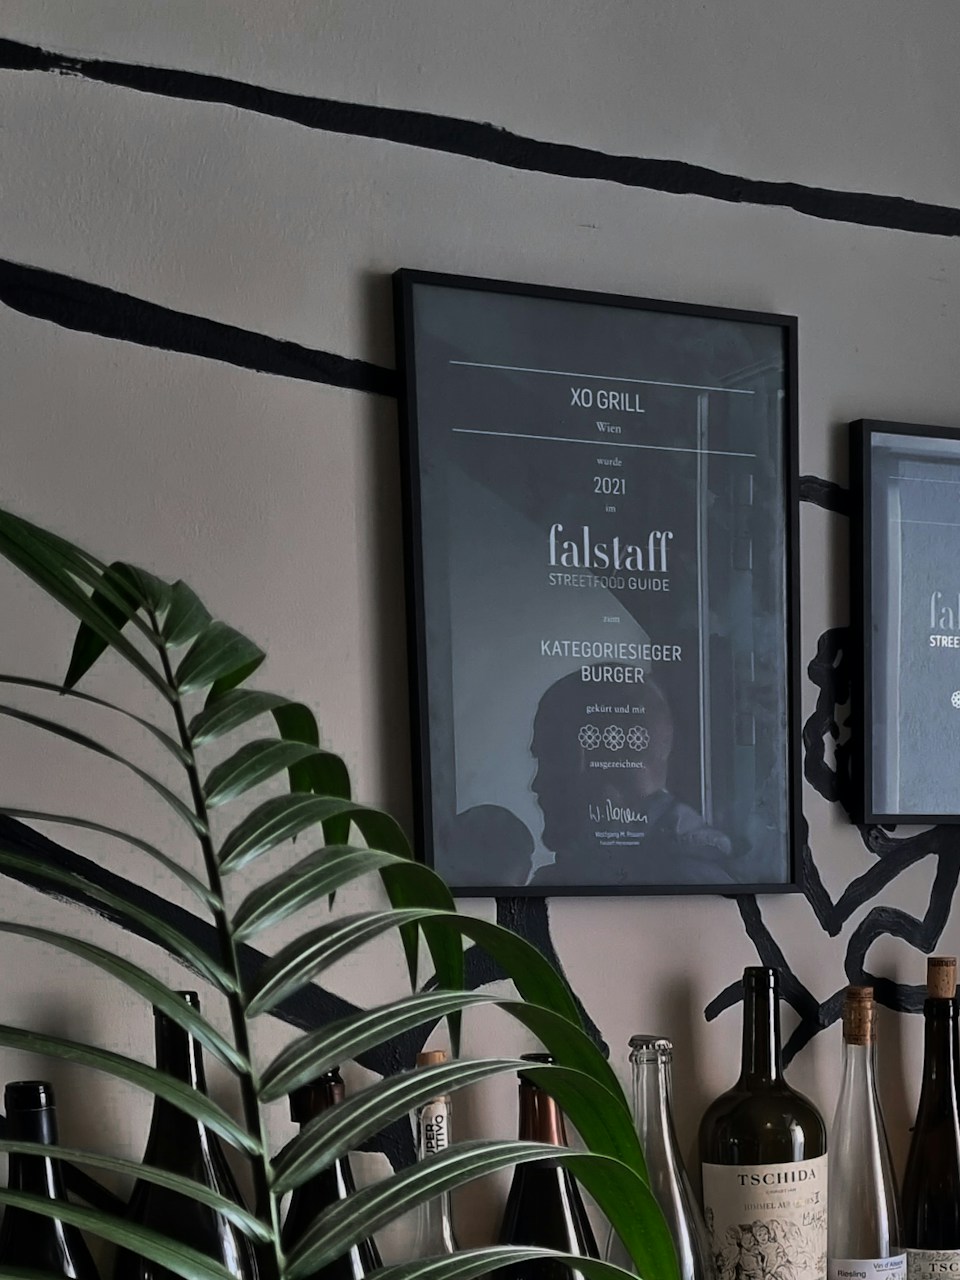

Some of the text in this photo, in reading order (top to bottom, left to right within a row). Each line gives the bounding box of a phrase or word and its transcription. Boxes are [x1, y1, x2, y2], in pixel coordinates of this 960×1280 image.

[570, 387, 645, 413] XO GRILL
[595, 421, 622, 434] Wien
[596, 457, 622, 467] wurde
[593, 476, 626, 494] 2021
[604, 504, 617, 513] im
[547, 523, 674, 573] falstaff
[548, 573, 671, 591] STREETFOOD GUIDE
[540, 639, 682, 662] KATEGORIESIEGER
[580, 665, 645, 683] BURGER
[586, 704, 646, 714] gekürt und mit
[589, 760, 646, 770] ausgezeichnet.
[737, 1168, 817, 1186] TSCHIDA
[837, 1270, 867, 1279] Riesling
